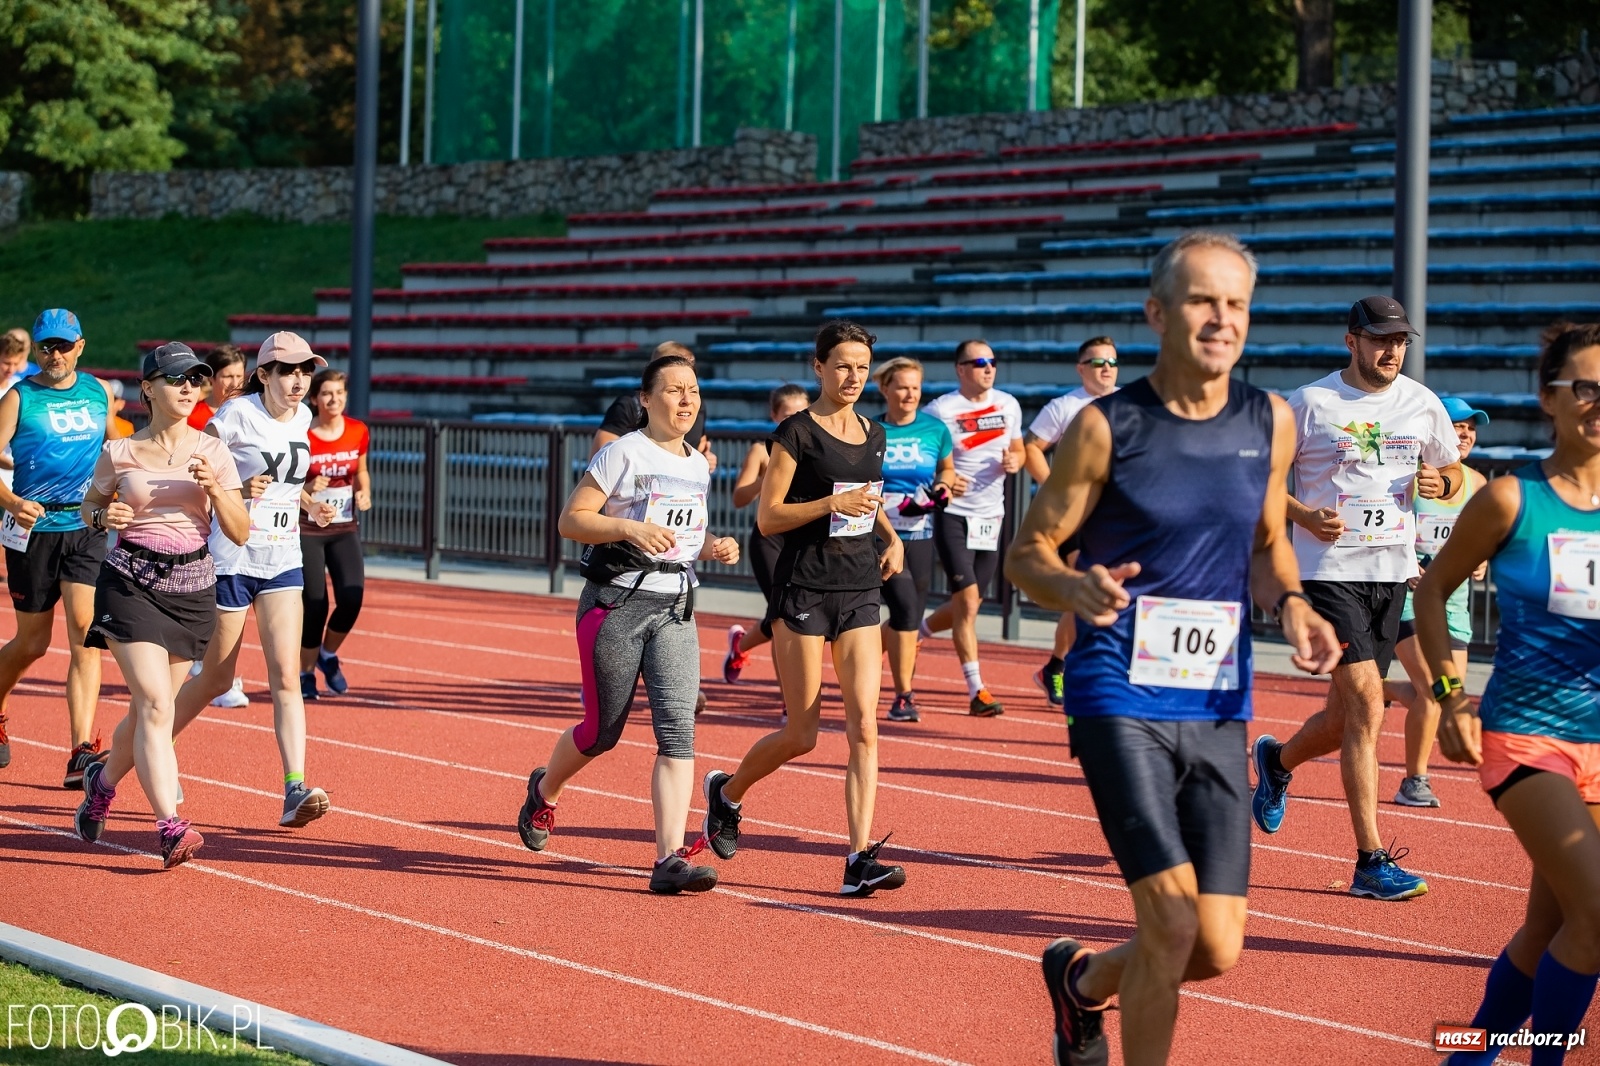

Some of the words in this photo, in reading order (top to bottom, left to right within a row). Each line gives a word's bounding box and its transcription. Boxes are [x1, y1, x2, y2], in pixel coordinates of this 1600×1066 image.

[62, 434, 91, 442] RACIBÓRZ
[5, 514, 16, 531] 59
[273, 511, 288, 528] 10
[666, 508, 692, 527] 161
[1363, 509, 1385, 527] 73
[1433, 525, 1452, 539] 10
[1172, 626, 1216, 655] 106
